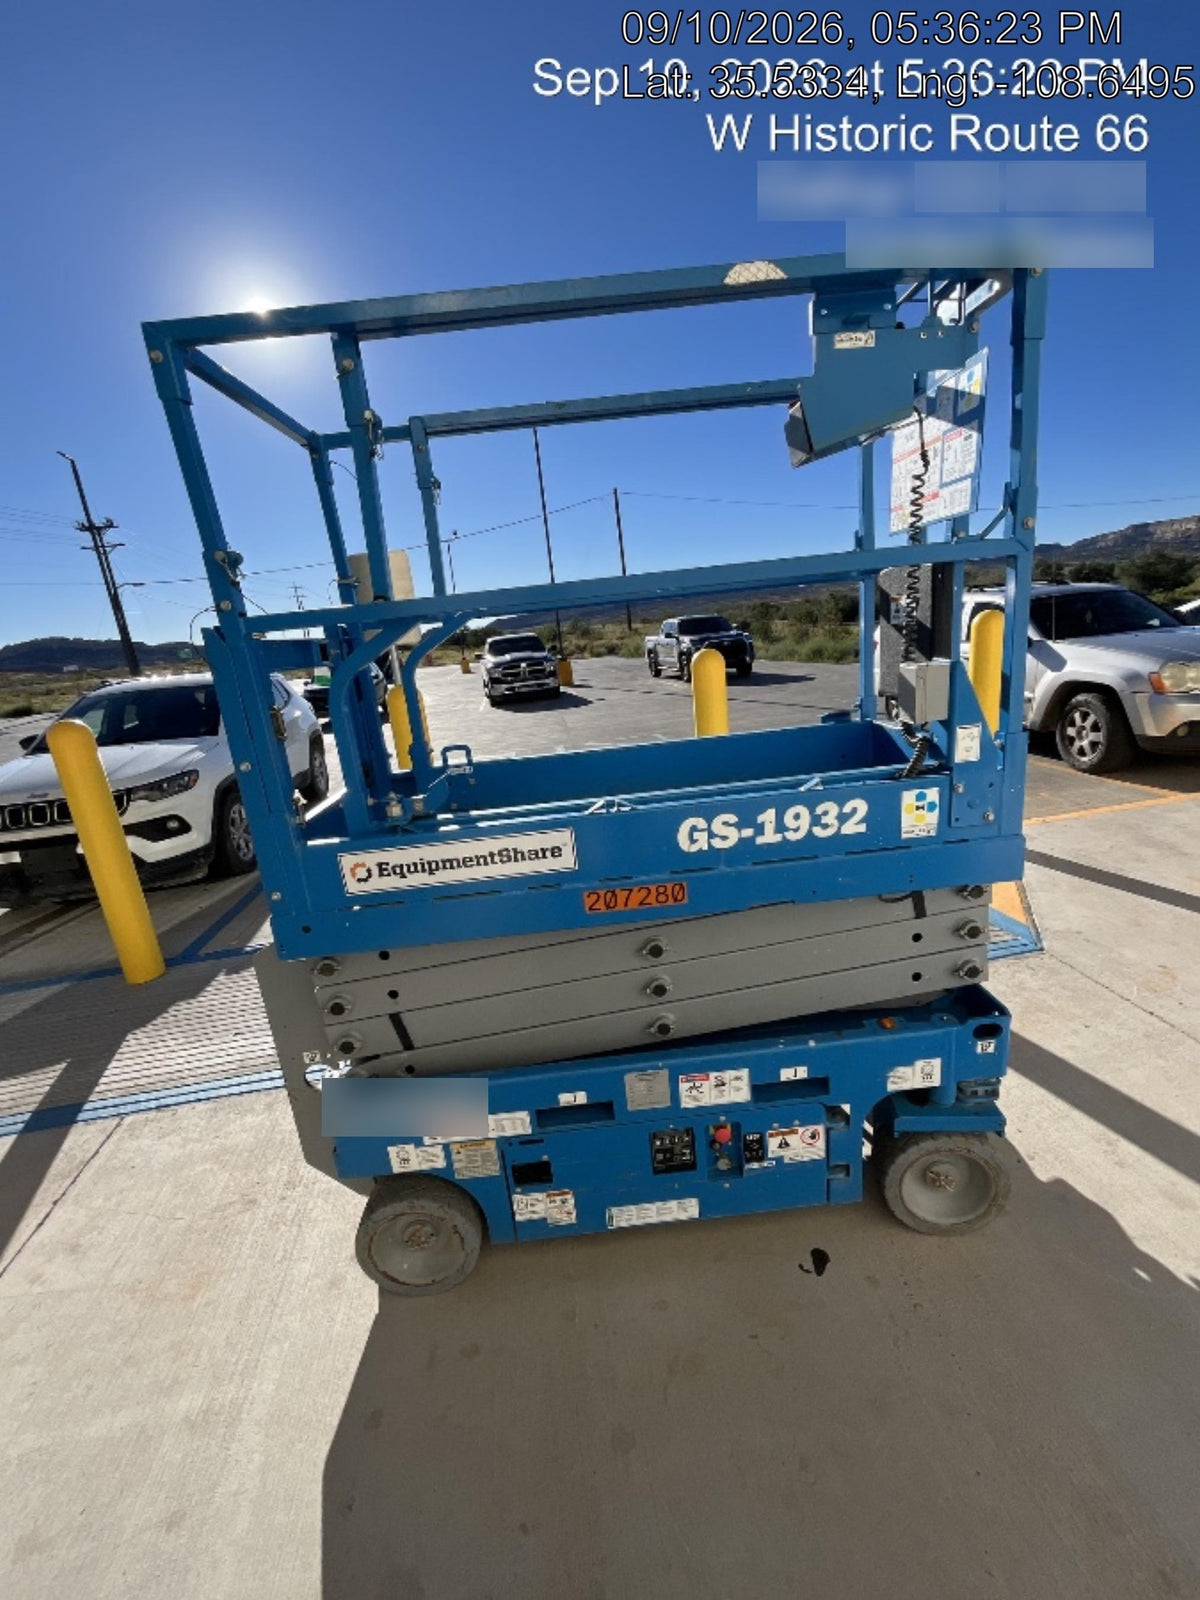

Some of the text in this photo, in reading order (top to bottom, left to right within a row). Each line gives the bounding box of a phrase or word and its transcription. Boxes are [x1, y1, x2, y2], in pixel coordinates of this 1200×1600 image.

[677, 798, 869, 853] GS-1932
[376, 843, 565, 880] EquipmentShare
[585, 882, 687, 912] 207280
